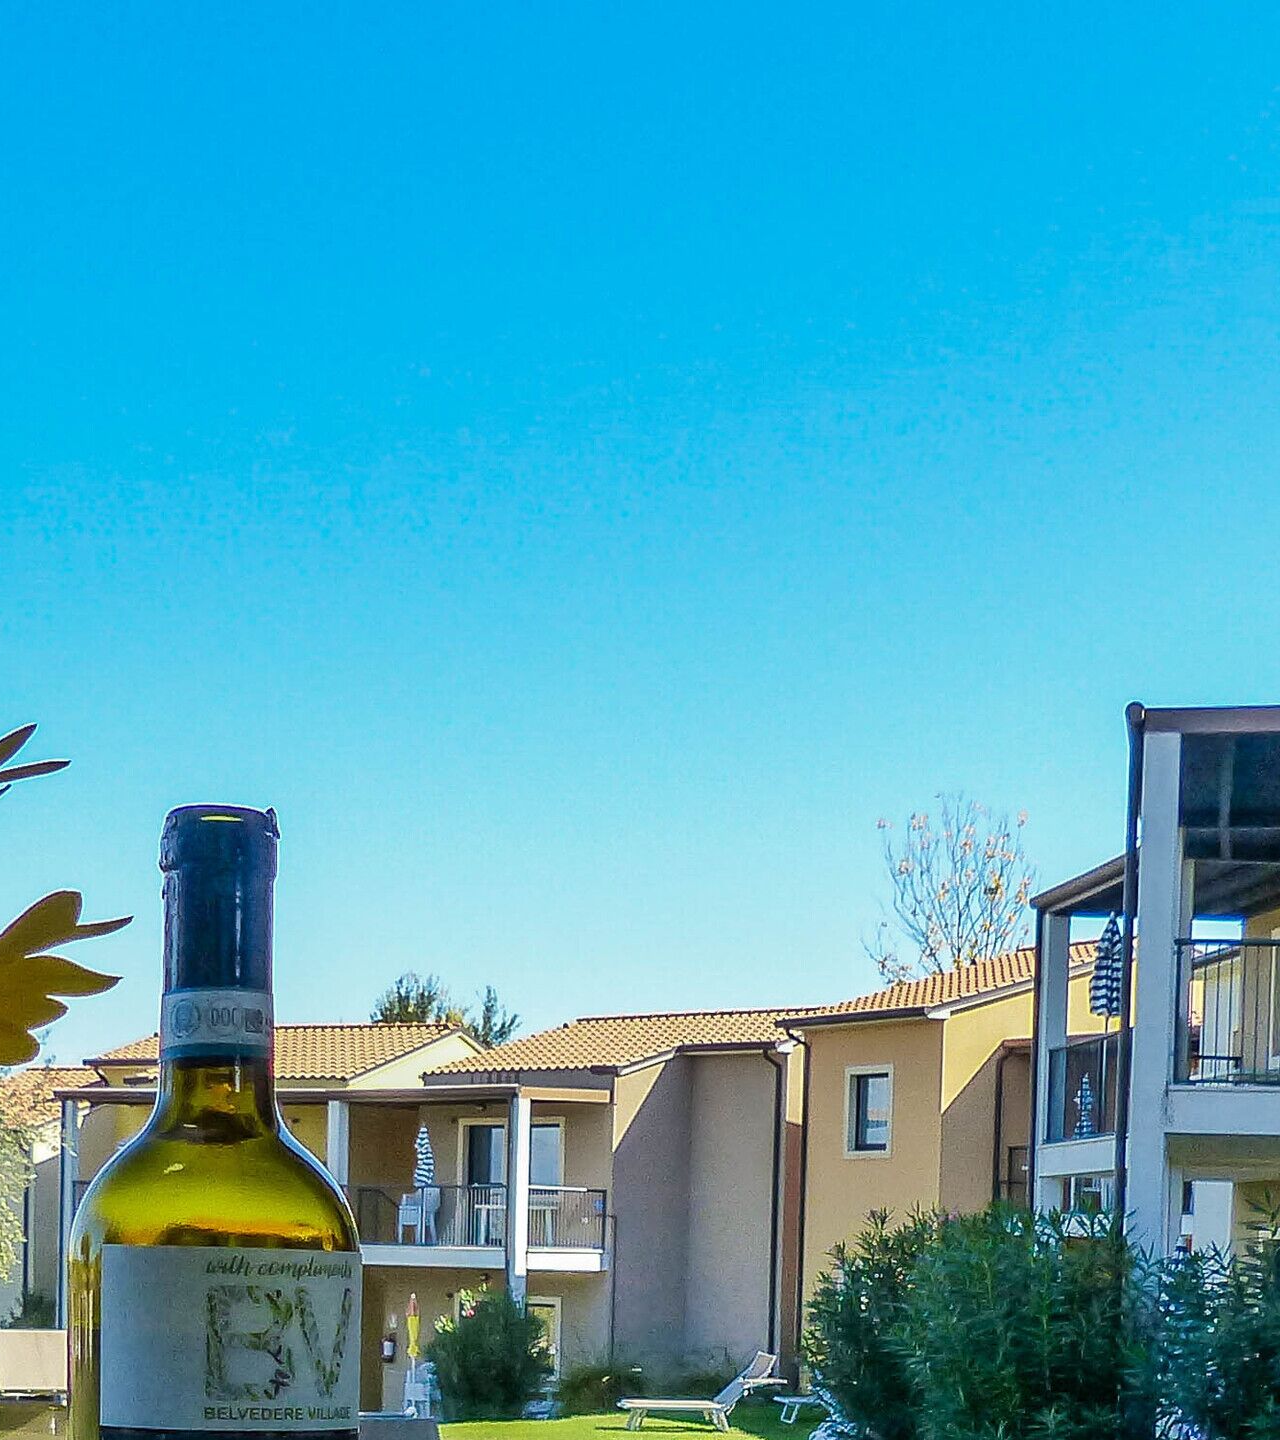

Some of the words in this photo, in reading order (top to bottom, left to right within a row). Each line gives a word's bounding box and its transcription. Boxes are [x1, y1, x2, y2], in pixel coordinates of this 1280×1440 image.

[206, 1254, 249, 1277] with
[205, 1285, 352, 1402] BV
[204, 1406, 304, 1421] BELVEDERE
[308, 1406, 351, 1420] VILLAGE
